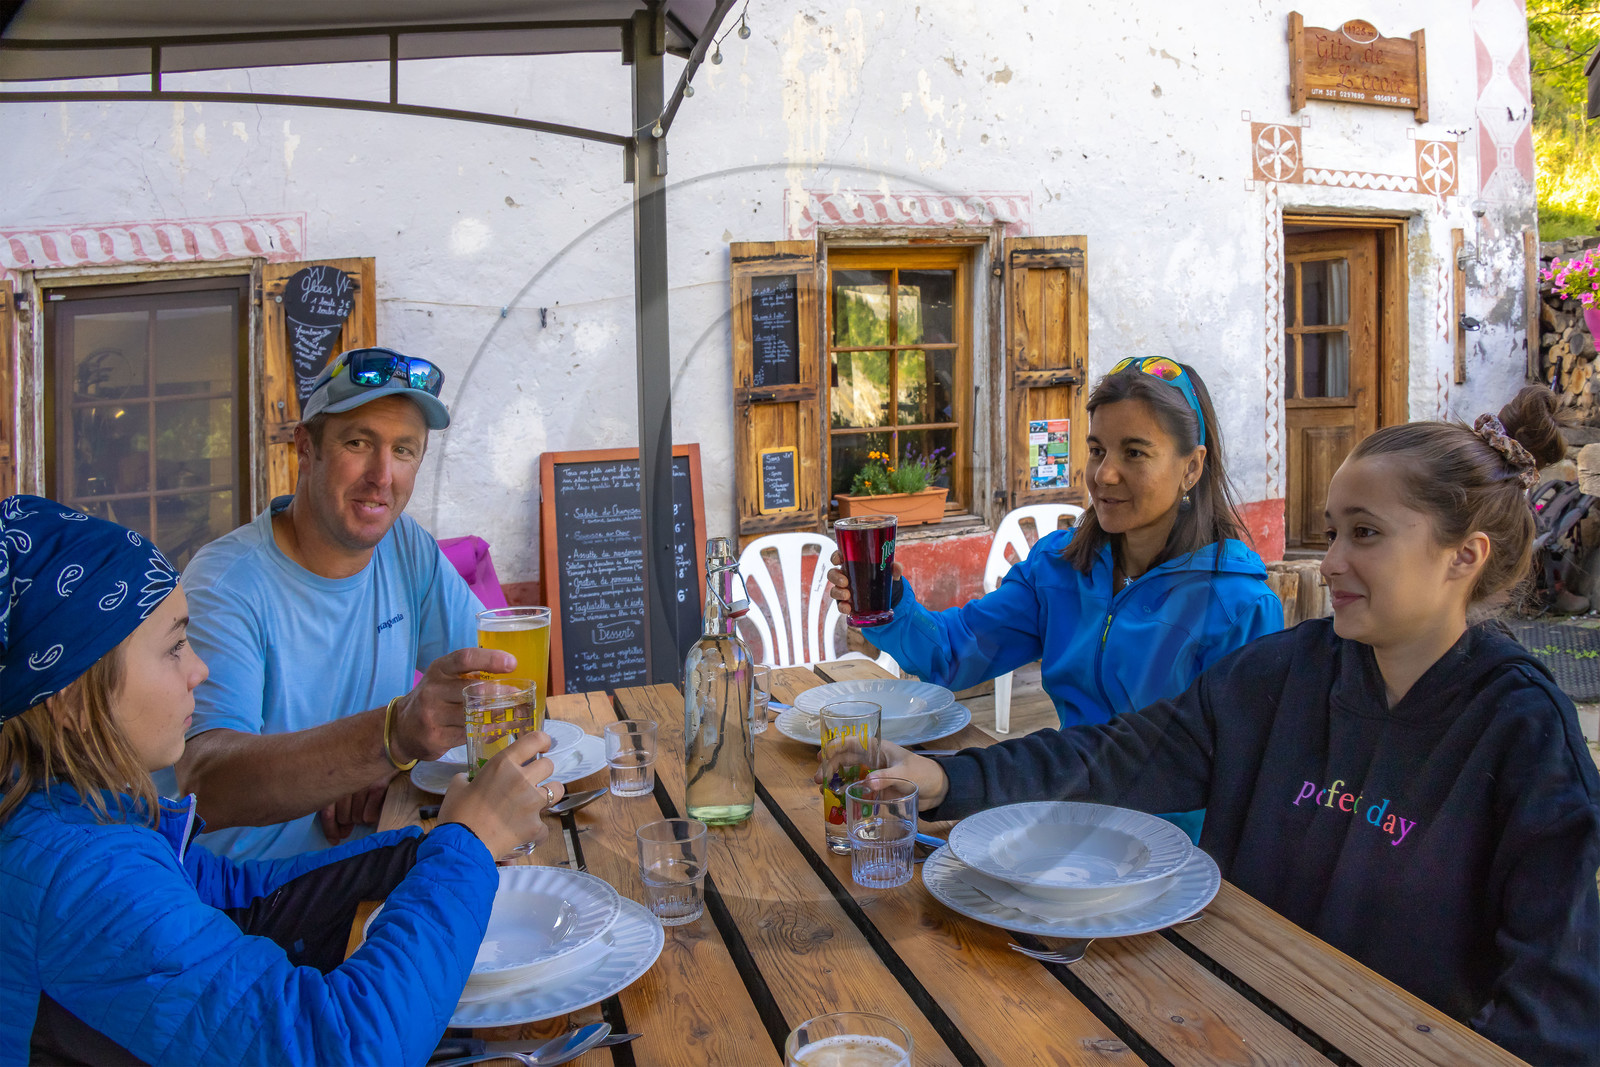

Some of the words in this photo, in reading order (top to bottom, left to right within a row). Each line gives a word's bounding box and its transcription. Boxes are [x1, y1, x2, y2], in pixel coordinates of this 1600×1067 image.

[1364, 42, 1384, 65] de
[600, 626, 635, 640] Desserts
[581, 651, 600, 660] Tarte
[582, 662, 598, 671] Tarte
[1366, 798, 1417, 846] day
